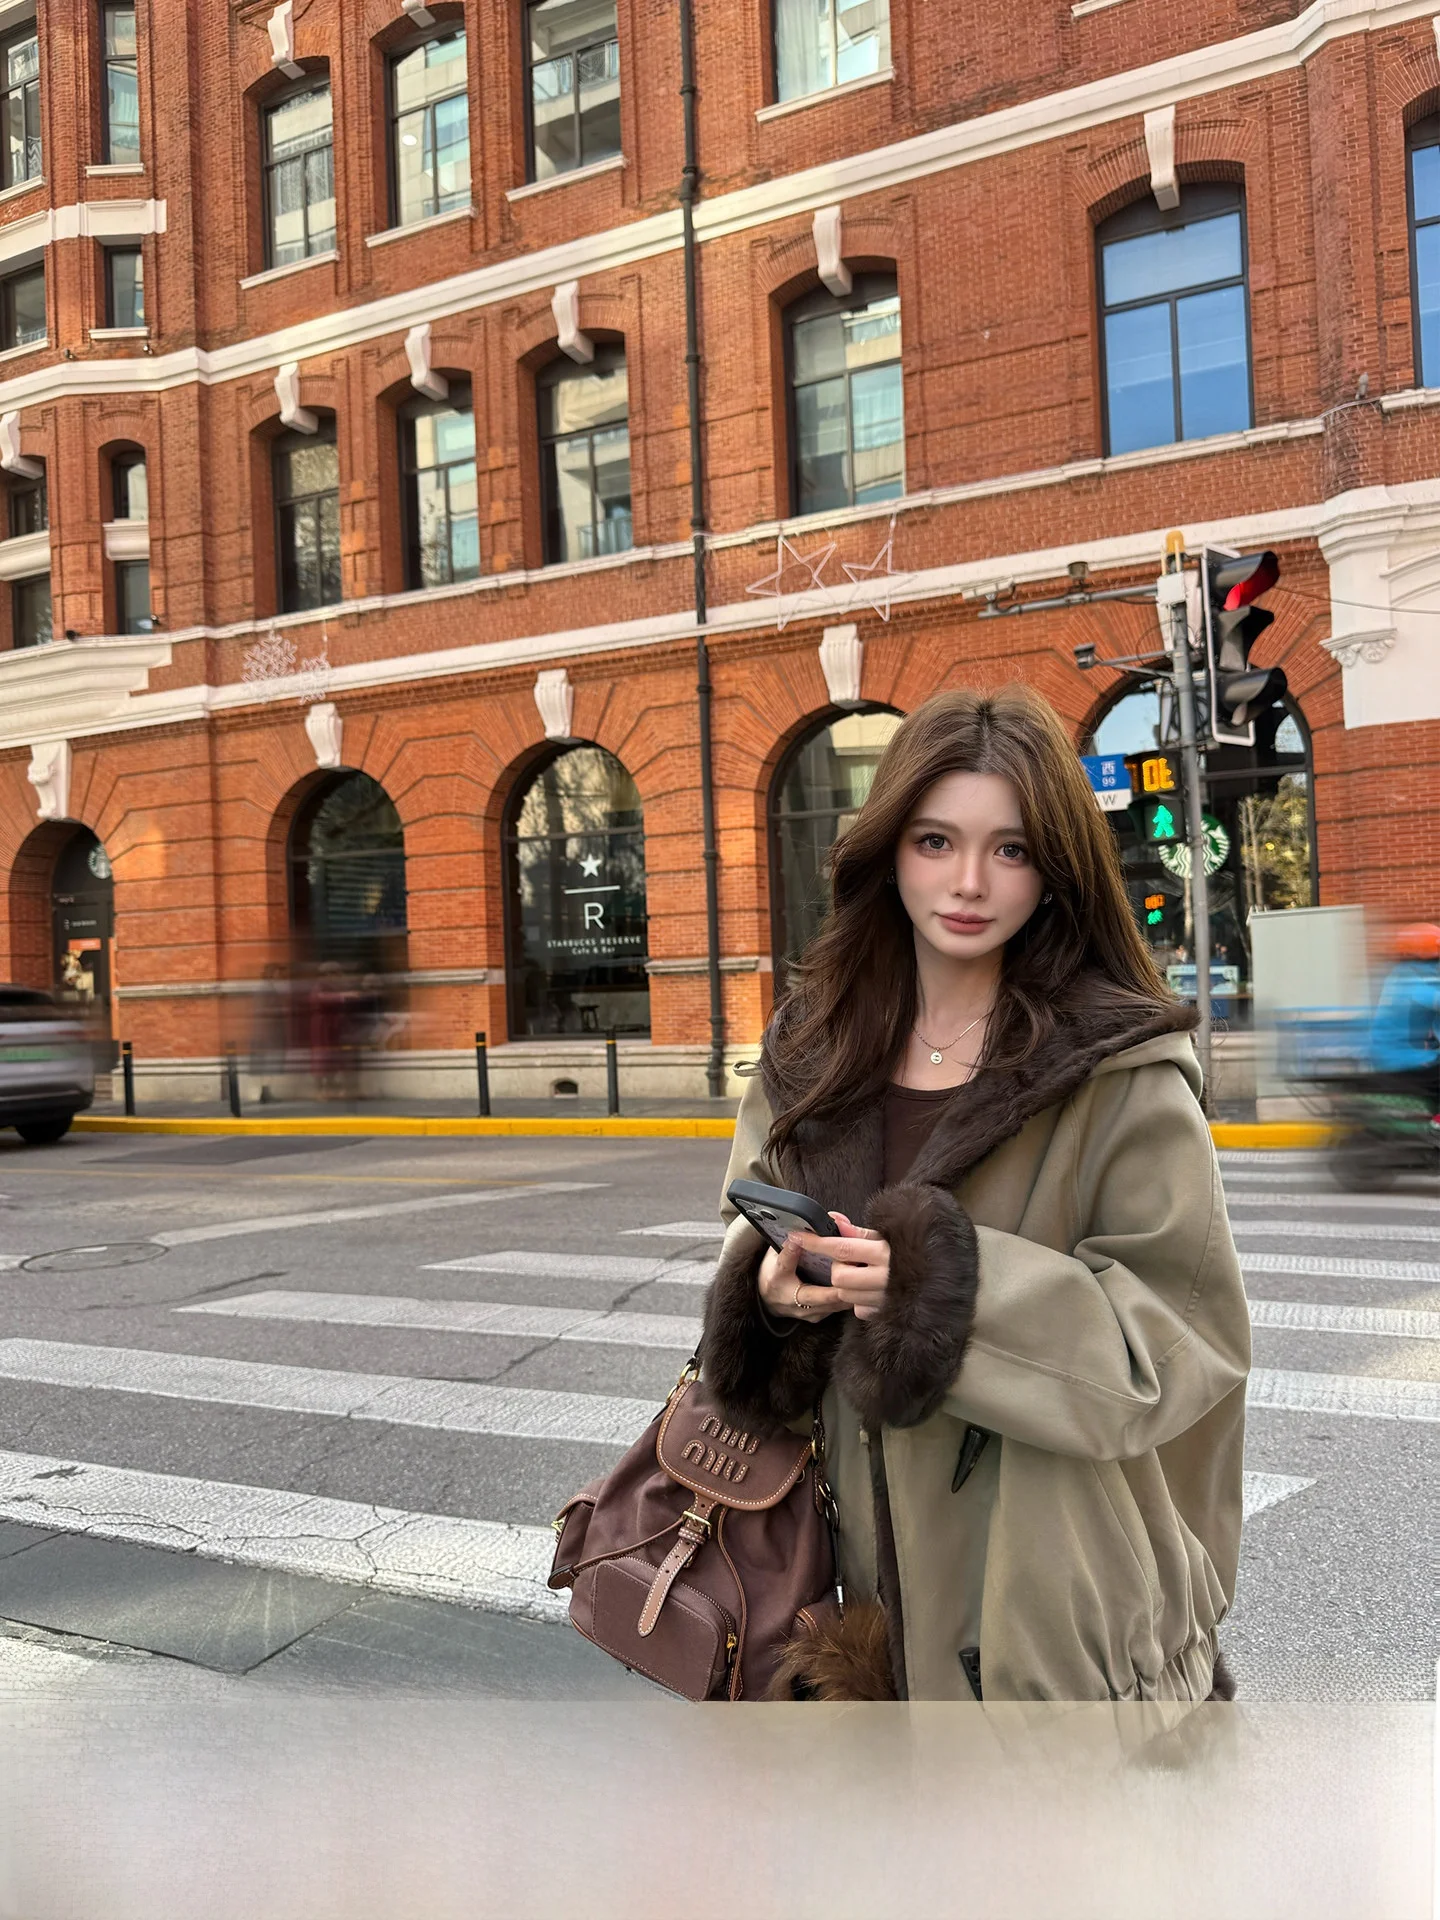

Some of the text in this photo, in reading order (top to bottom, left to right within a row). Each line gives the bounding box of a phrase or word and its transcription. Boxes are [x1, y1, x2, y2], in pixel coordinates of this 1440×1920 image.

[1101, 761, 1116, 775] 西
[1102, 794, 1116, 806] W
[584, 902, 604, 930] R
[547, 936, 640, 948] STARBUCKS RESERVE
[602, 945, 615, 954] Bar
